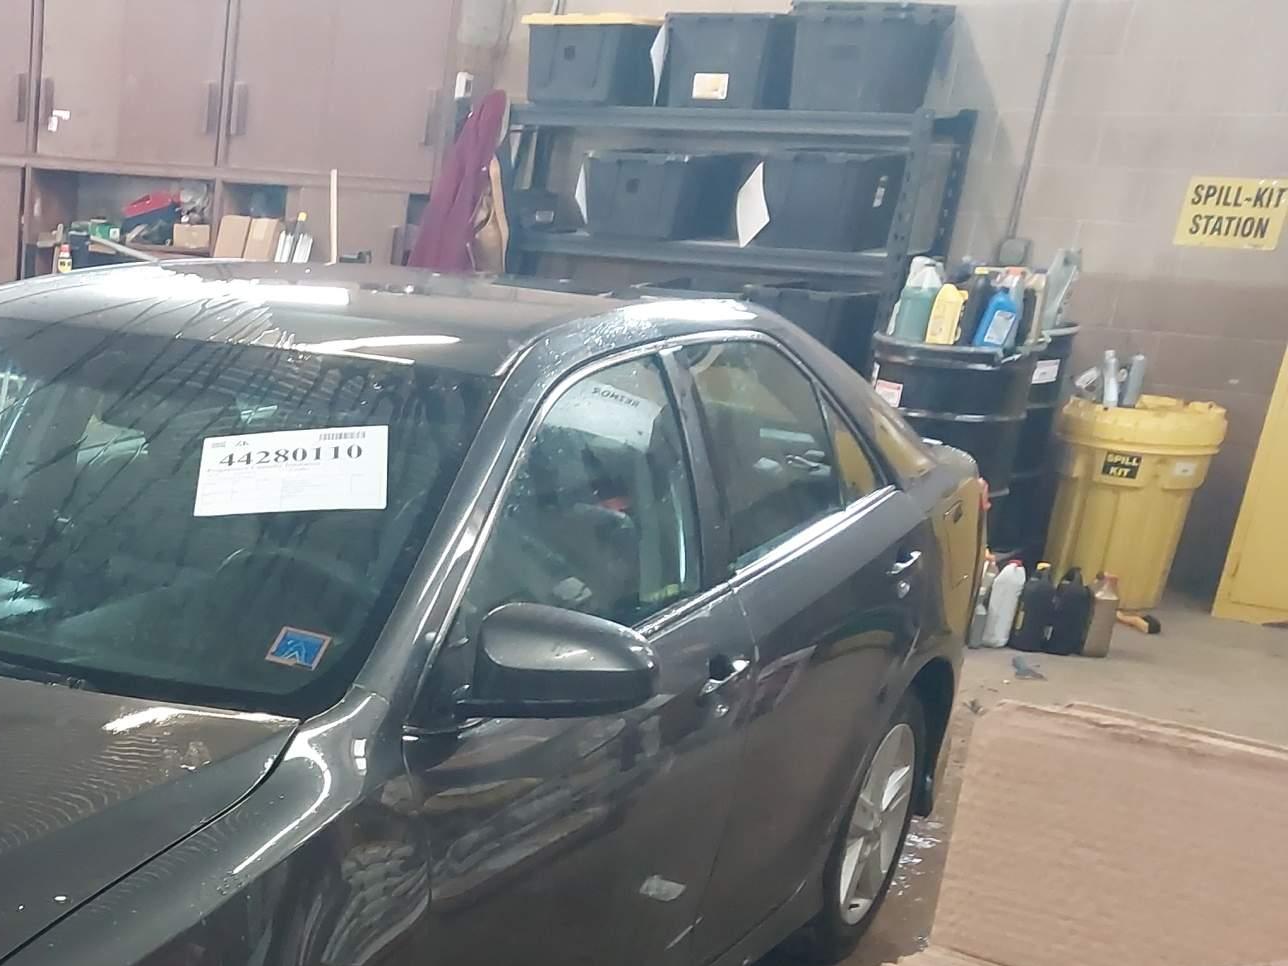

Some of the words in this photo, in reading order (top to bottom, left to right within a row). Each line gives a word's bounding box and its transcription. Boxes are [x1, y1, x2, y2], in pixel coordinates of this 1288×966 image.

[1191, 184, 1288, 208] SPILL-KIT
[1189, 214, 1270, 238] STATION
[219, 443, 363, 467] 44280110
[1106, 453, 1140, 466] SPILL
[1108, 466, 1131, 478] KIT
